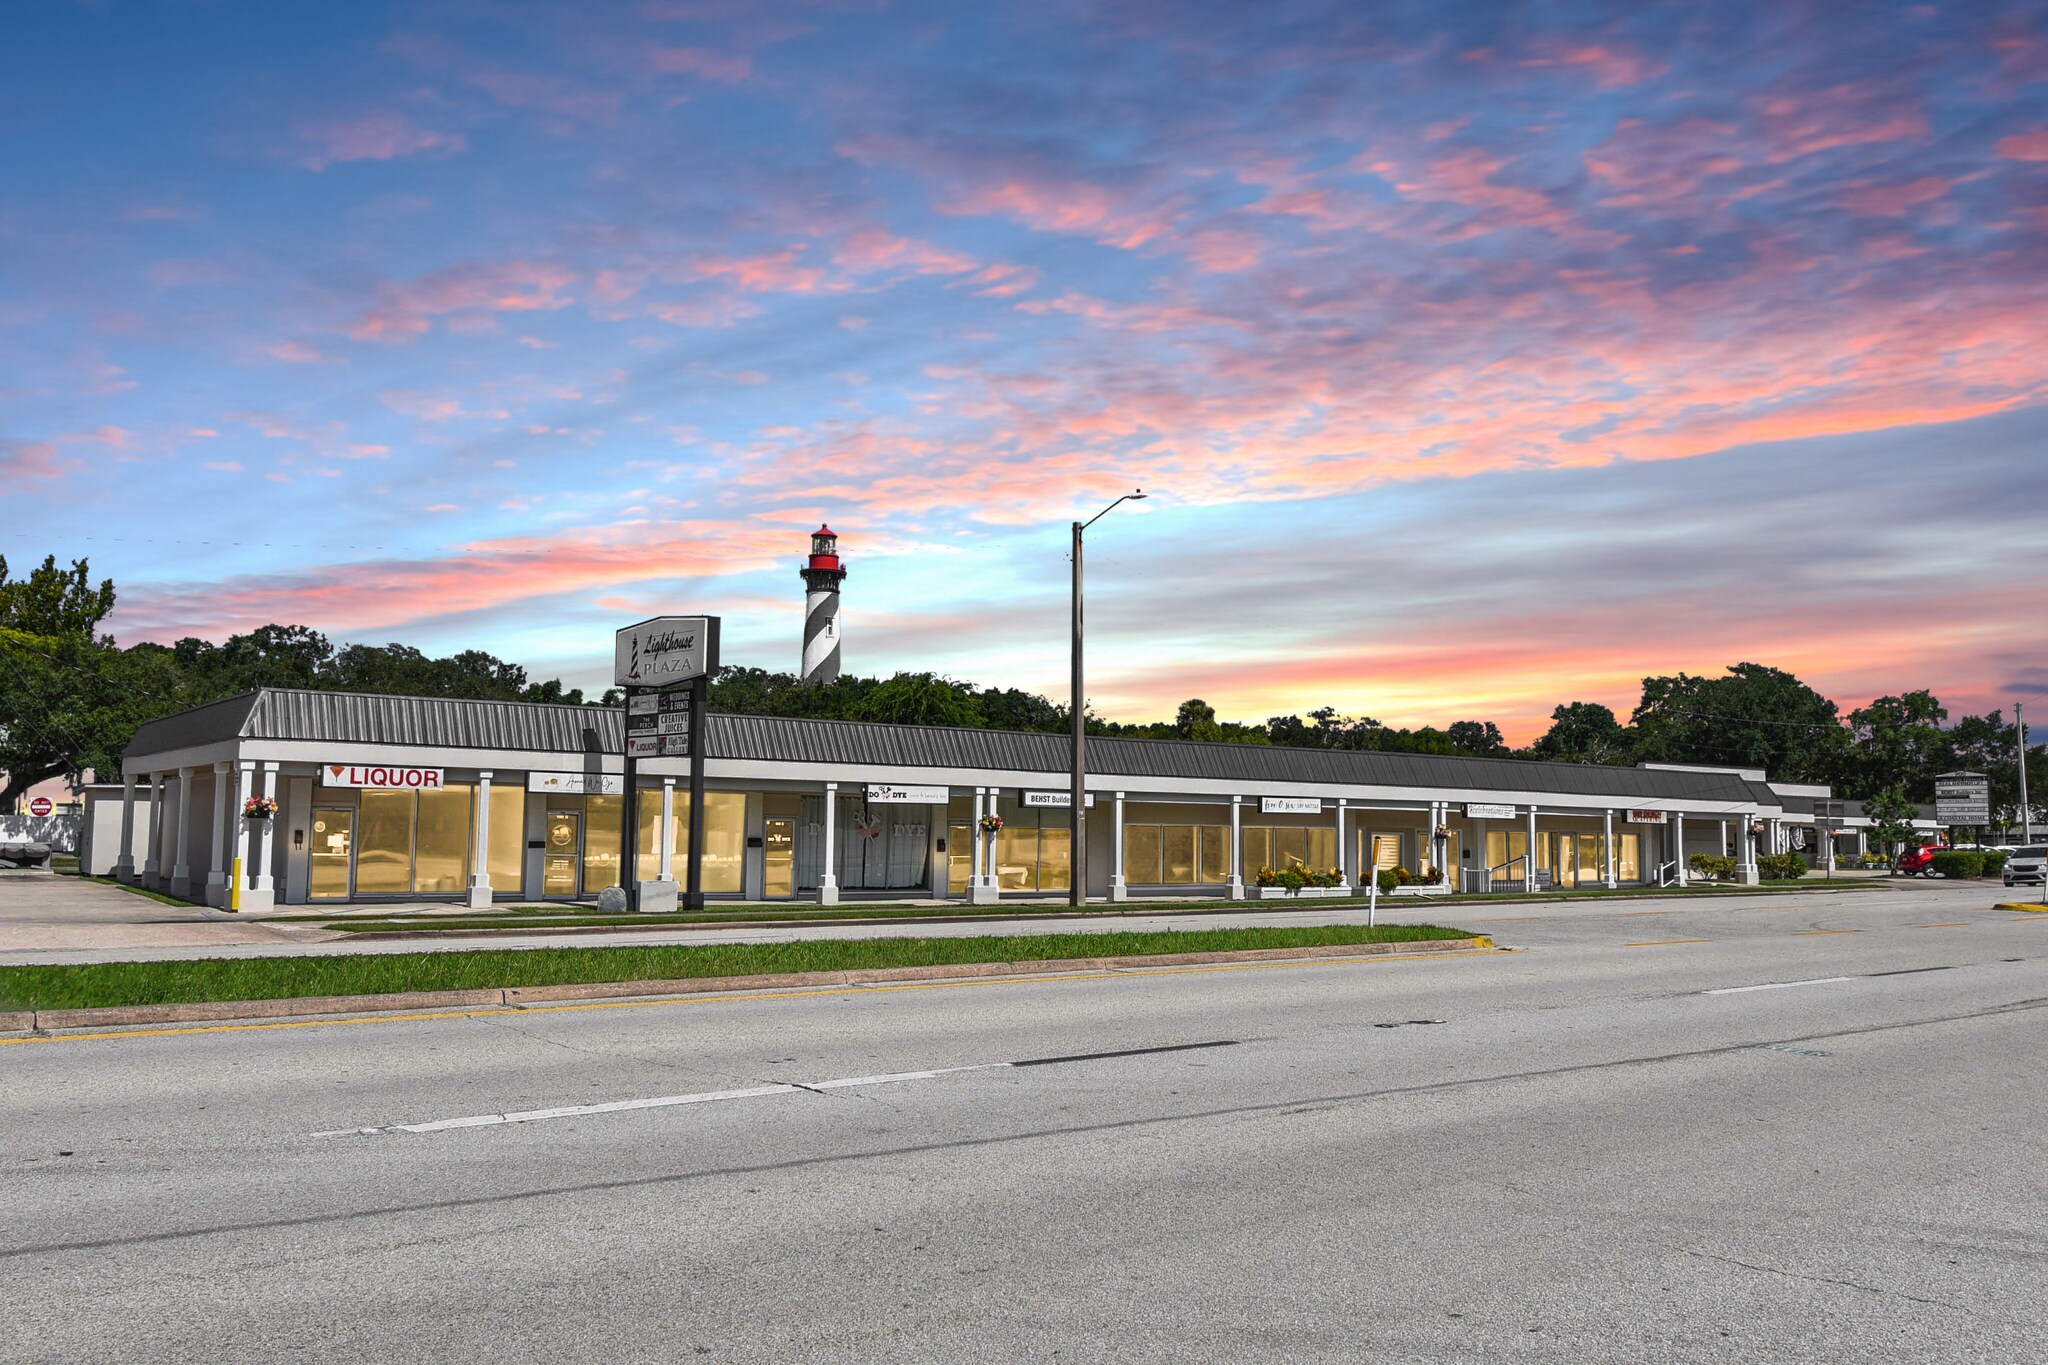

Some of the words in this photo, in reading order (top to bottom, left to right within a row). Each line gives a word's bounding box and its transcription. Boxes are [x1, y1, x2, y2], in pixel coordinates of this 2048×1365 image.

[644, 630, 694, 660] Lighthouse
[644, 658, 692, 675] PLAZA
[674, 701, 688, 710] EVENTS
[660, 713, 688, 724] CREATIVE
[664, 722, 683, 732] JUICES
[636, 743, 656, 751] LIQUOR
[350, 768, 438, 786] LIQUOR
[1030, 795, 1051, 803] BEHST
[1051, 795, 1071, 804] Builde
[894, 824, 926, 836] DYE
